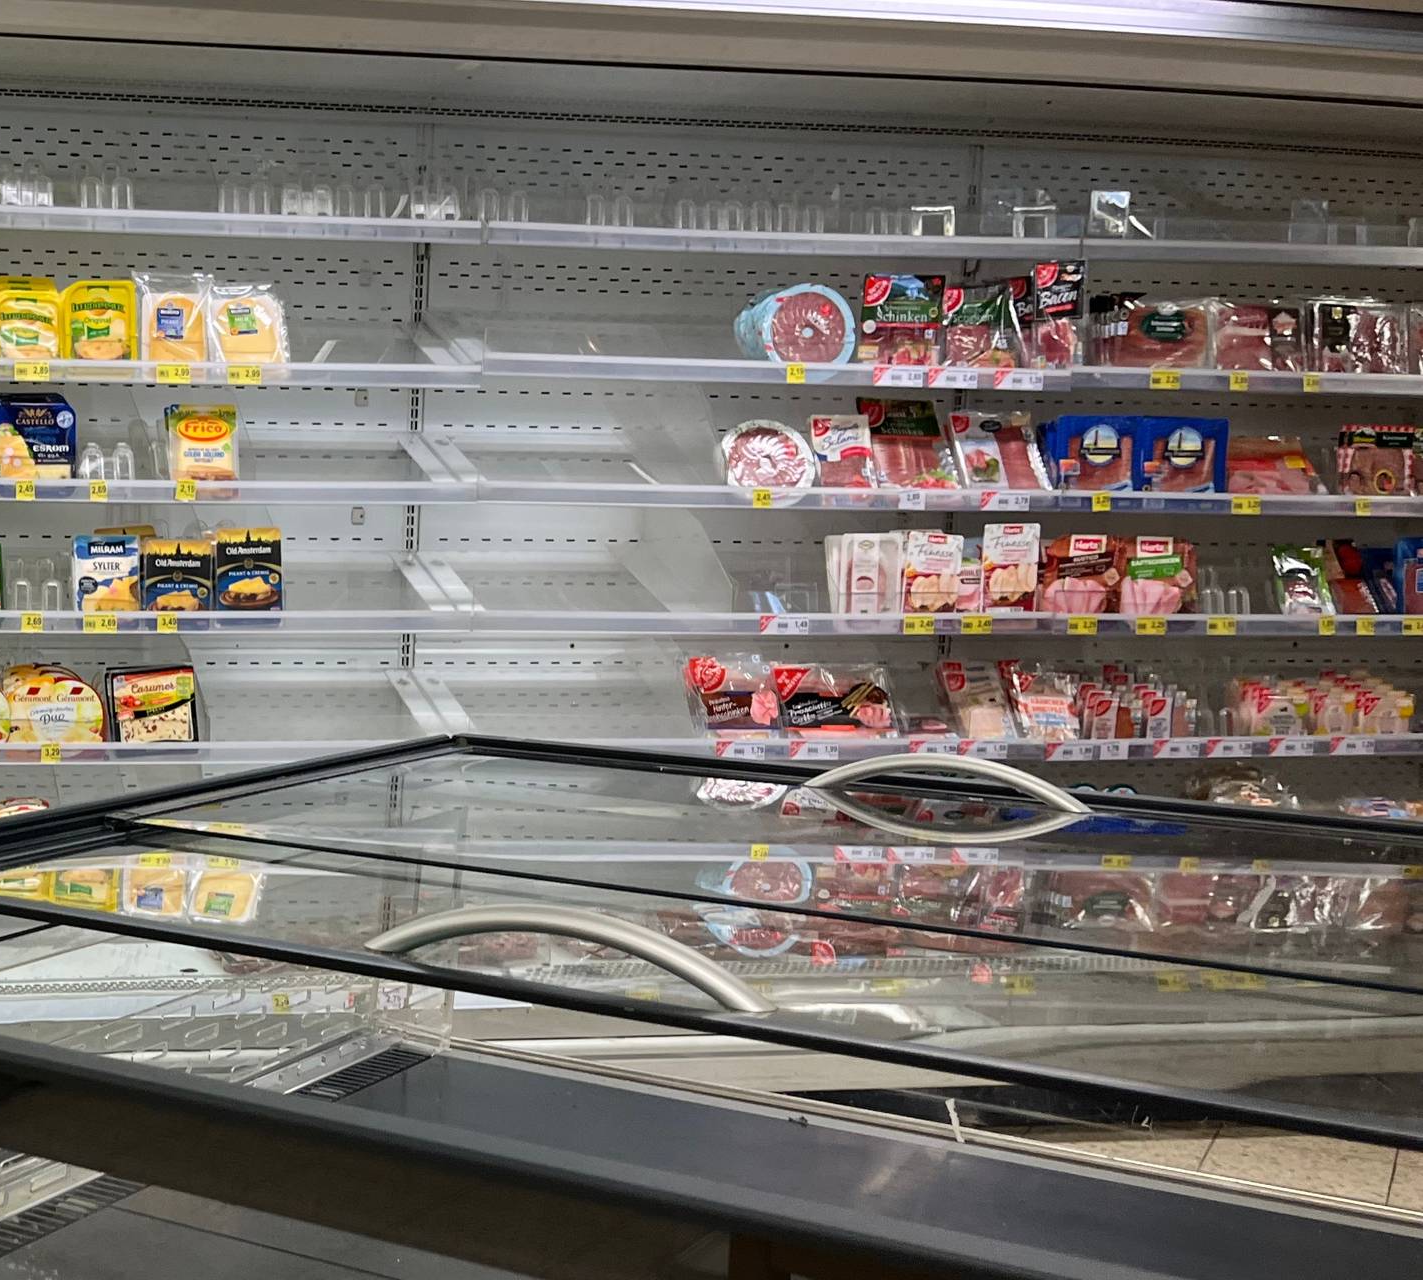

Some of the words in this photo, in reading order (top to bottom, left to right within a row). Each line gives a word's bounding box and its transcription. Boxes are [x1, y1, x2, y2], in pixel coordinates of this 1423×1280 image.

[876, 311, 927, 322] Schinken
[33, 366, 49, 375] 2,89
[183, 422, 222, 433] Frico
[18, 484, 34, 493] 2,49
[90, 545, 124, 554] MILRAM
[226, 546, 237, 554] Old
[237, 546, 272, 554] Amsterdam
[1075, 541, 1100, 550] Herta
[1141, 543, 1165, 552] Herta
[93, 562, 120, 570] SYLTER
[155, 558, 166, 567] Old
[166, 558, 201, 568] Amsterdam
[13, 694, 52, 703] Géramont
[56, 693, 95, 703] Géramont
[40, 712, 69, 723] Duo
